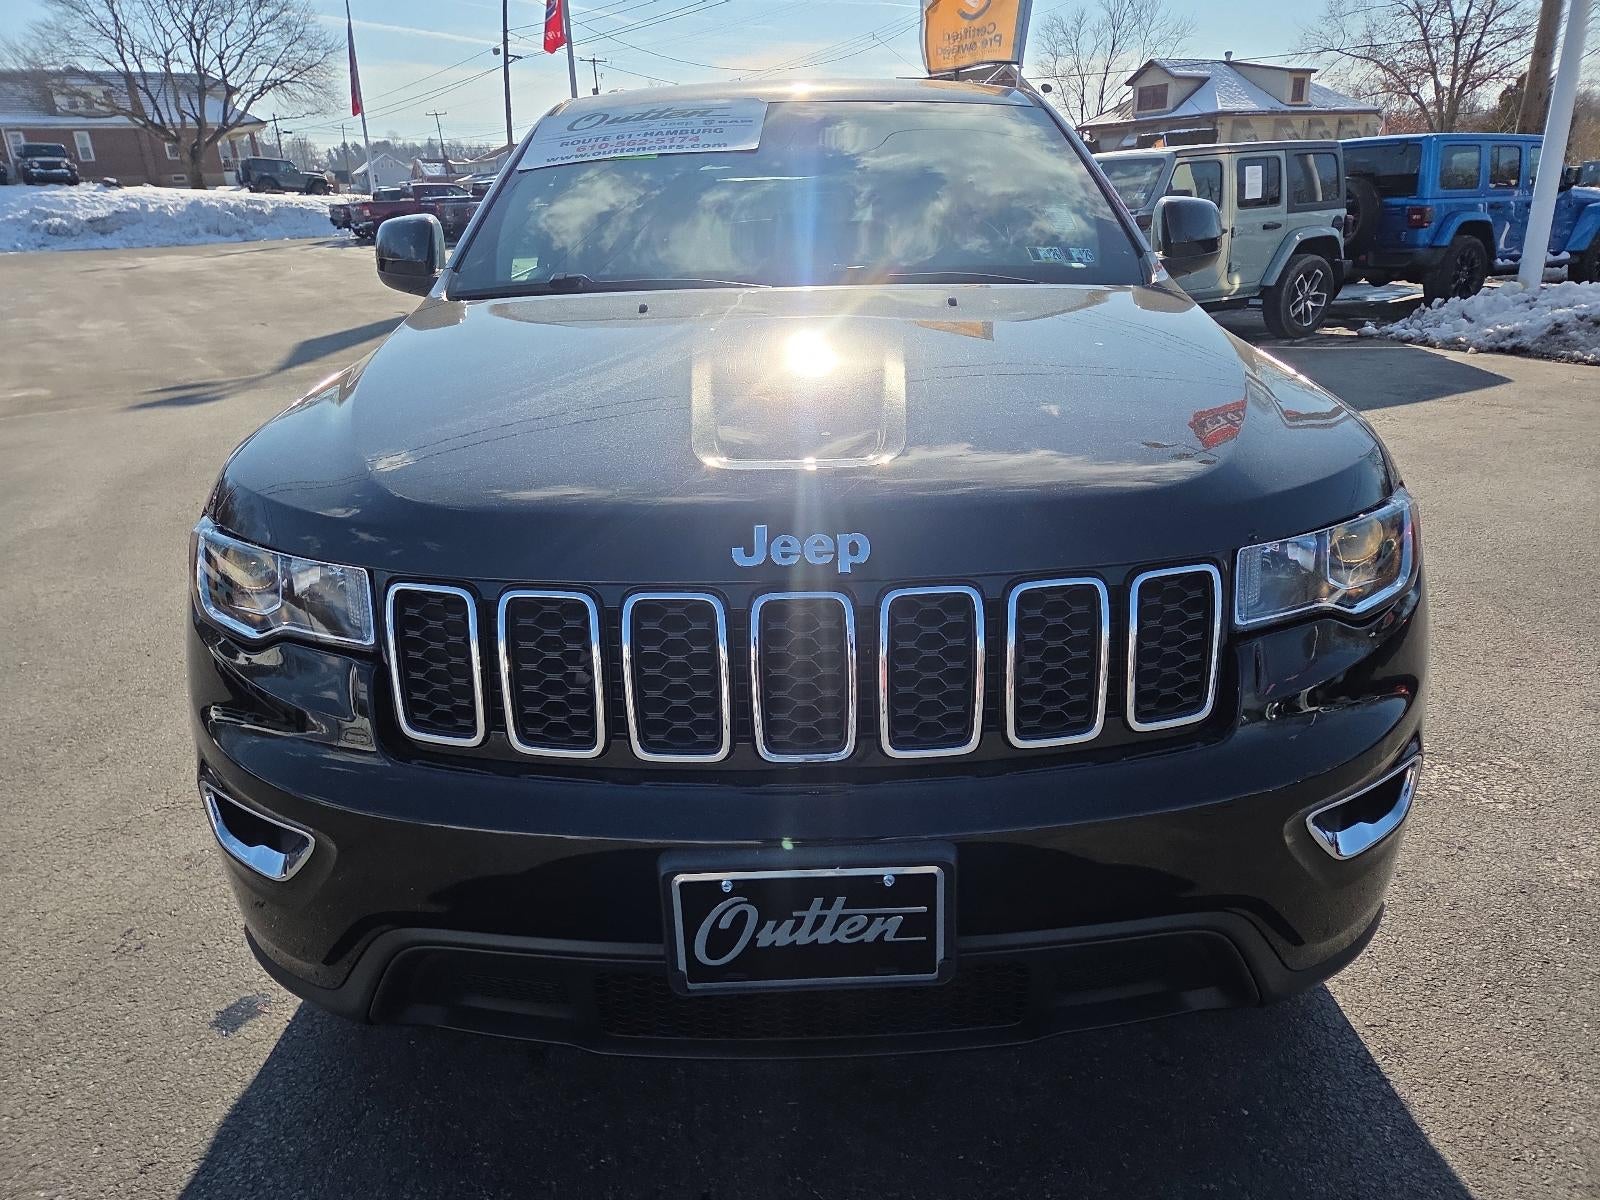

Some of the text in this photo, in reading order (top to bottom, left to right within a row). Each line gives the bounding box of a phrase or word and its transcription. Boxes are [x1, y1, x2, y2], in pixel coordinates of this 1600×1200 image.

[566, 106, 731, 132] Outten
[545, 141, 728, 163] www.outtencars.com
[559, 135, 610, 148] ROUTE
[575, 135, 701, 154] 610-562-5174
[731, 524, 871, 574] Jeep
[694, 896, 928, 966] Outten
